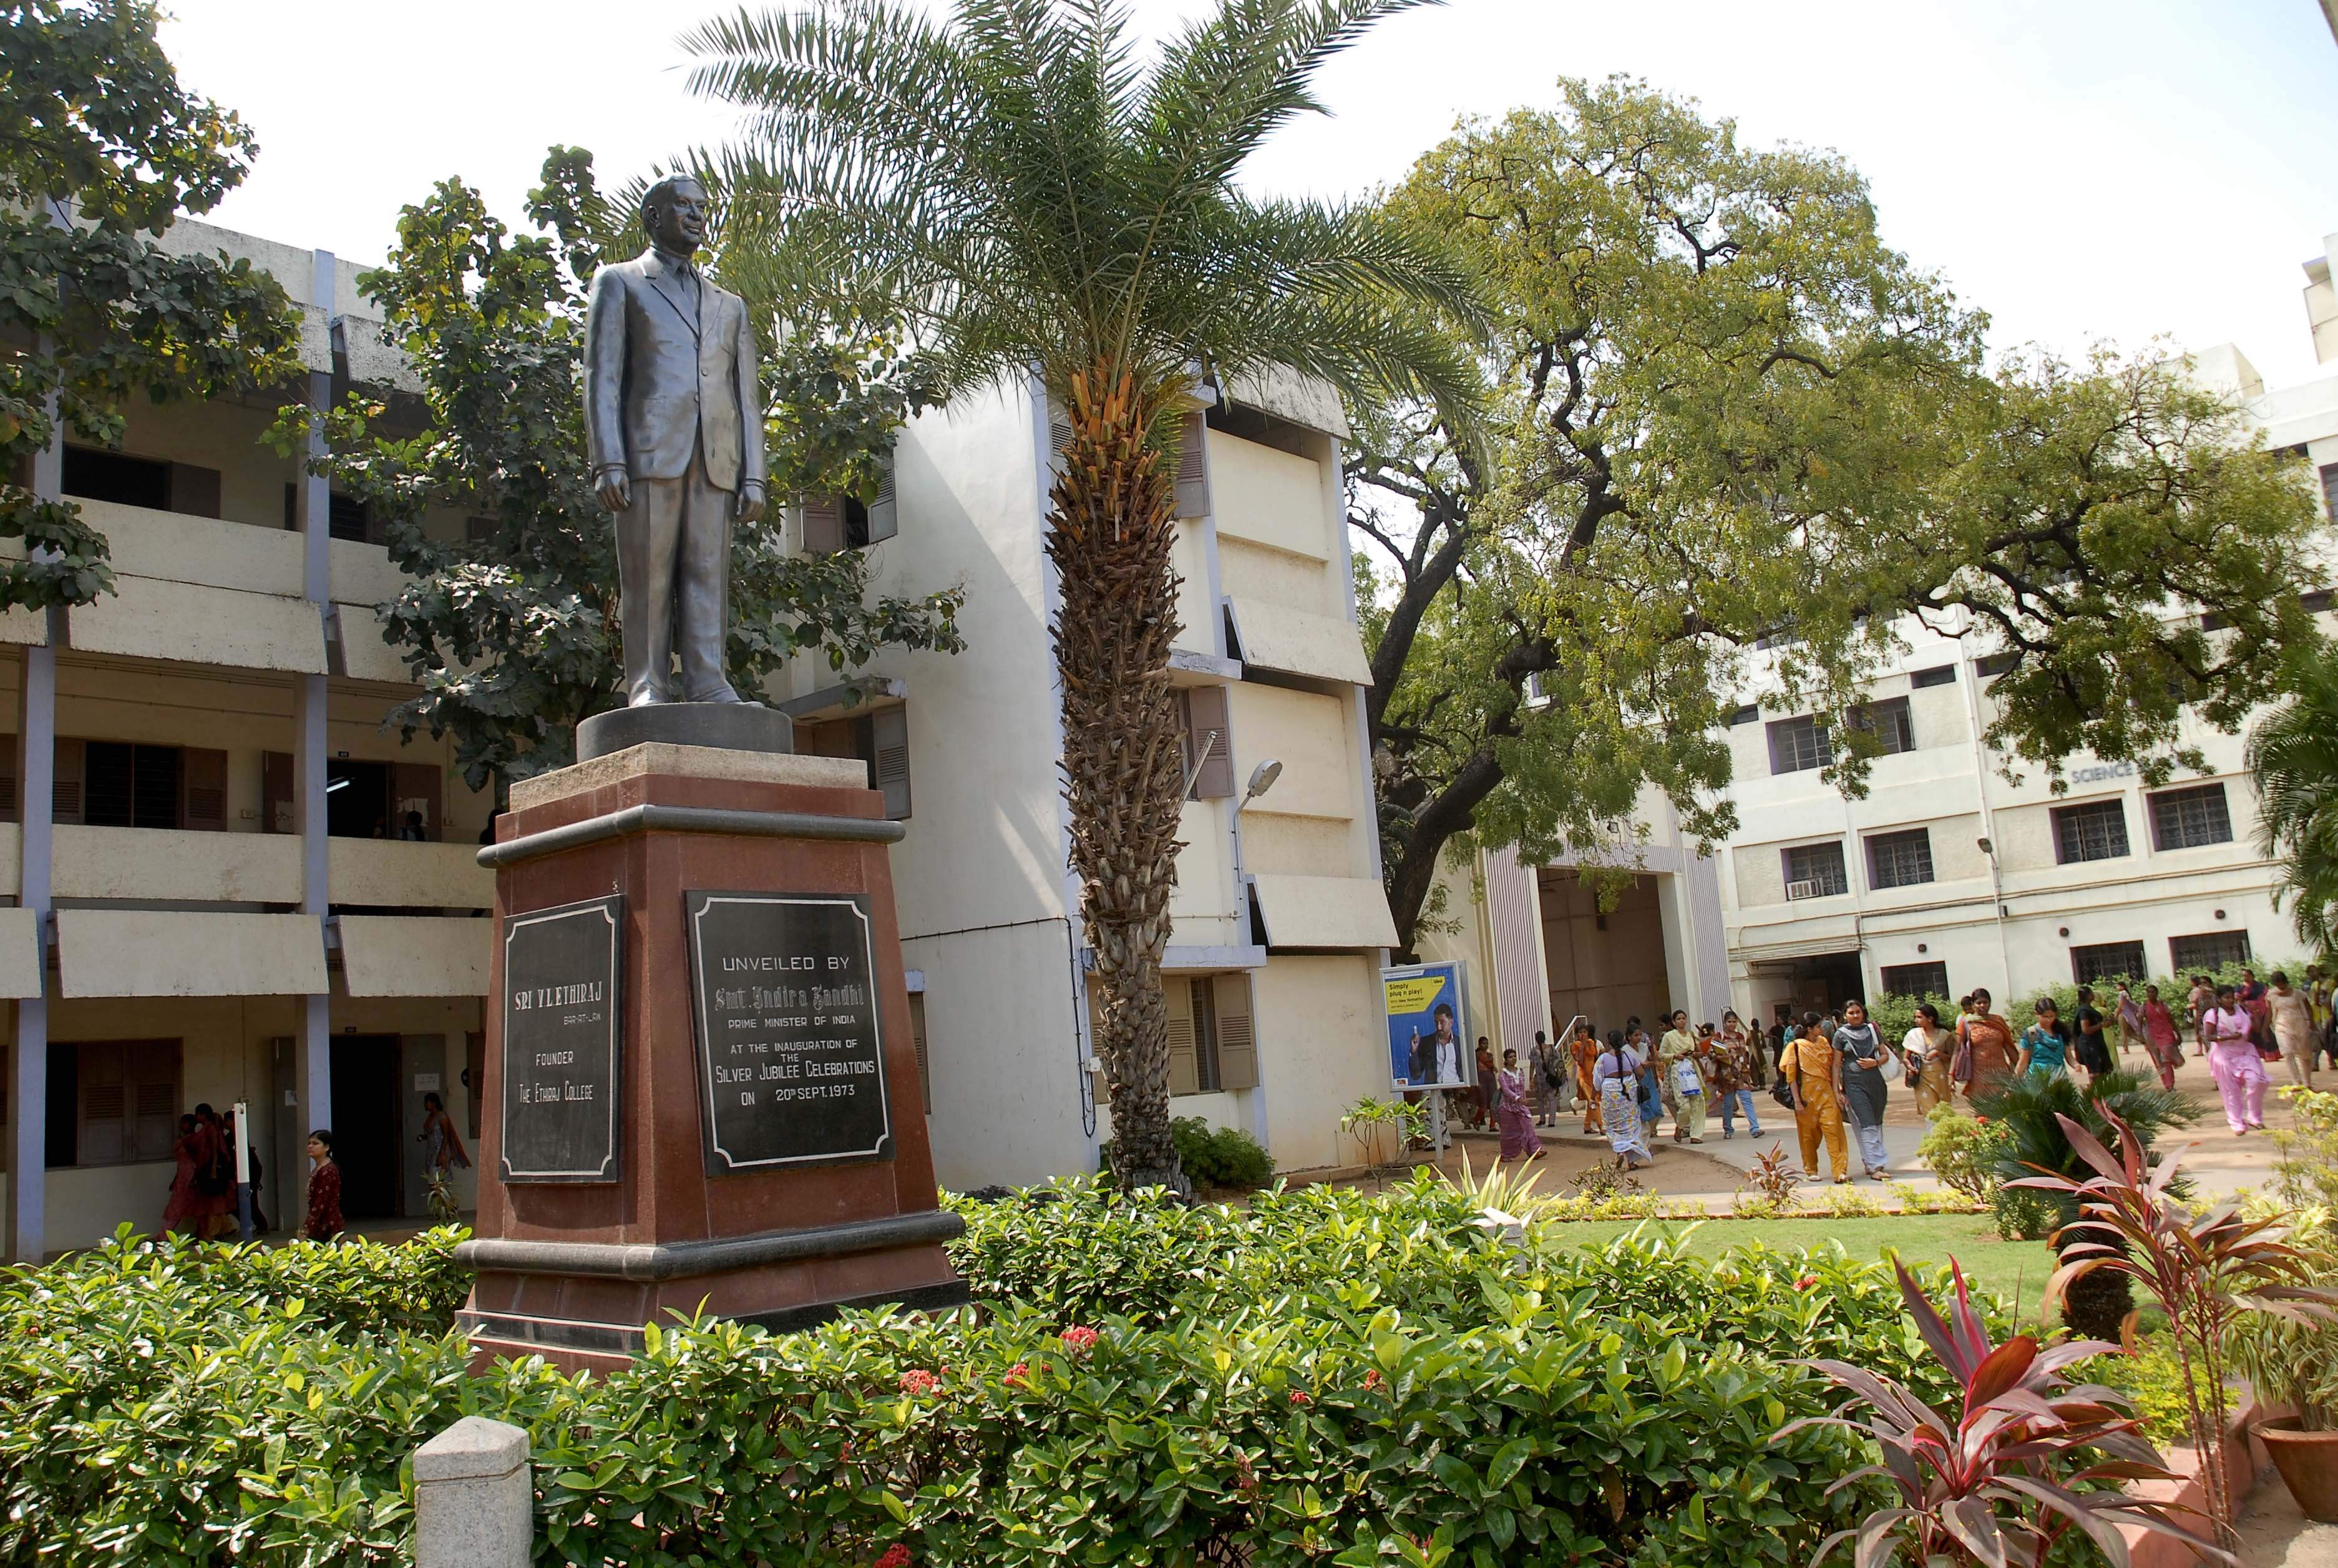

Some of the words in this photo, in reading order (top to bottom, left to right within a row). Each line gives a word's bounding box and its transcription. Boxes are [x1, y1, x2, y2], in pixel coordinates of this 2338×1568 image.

[2071, 762, 2133, 784] SCIENCE
[723, 957, 814, 971] UNVEILED
[827, 957, 849, 970] BY
[515, 990, 532, 1010] SRI
[812, 983, 864, 1013] Gandhi
[728, 1018, 757, 1029] PRIME
[764, 1016, 807, 1028] MINISTER
[814, 1016, 827, 1025] OF
[832, 1015, 855, 1025] INDIA
[731, 1044, 743, 1054] AT
[748, 1043, 769, 1053] THE
[774, 1040, 842, 1052] INAUGURATION
[845, 1039, 857, 1048] OF
[536, 1051, 573, 1066] FOUNDER
[780, 1053, 799, 1063] THE
[741, 1091, 755, 1106] ON
